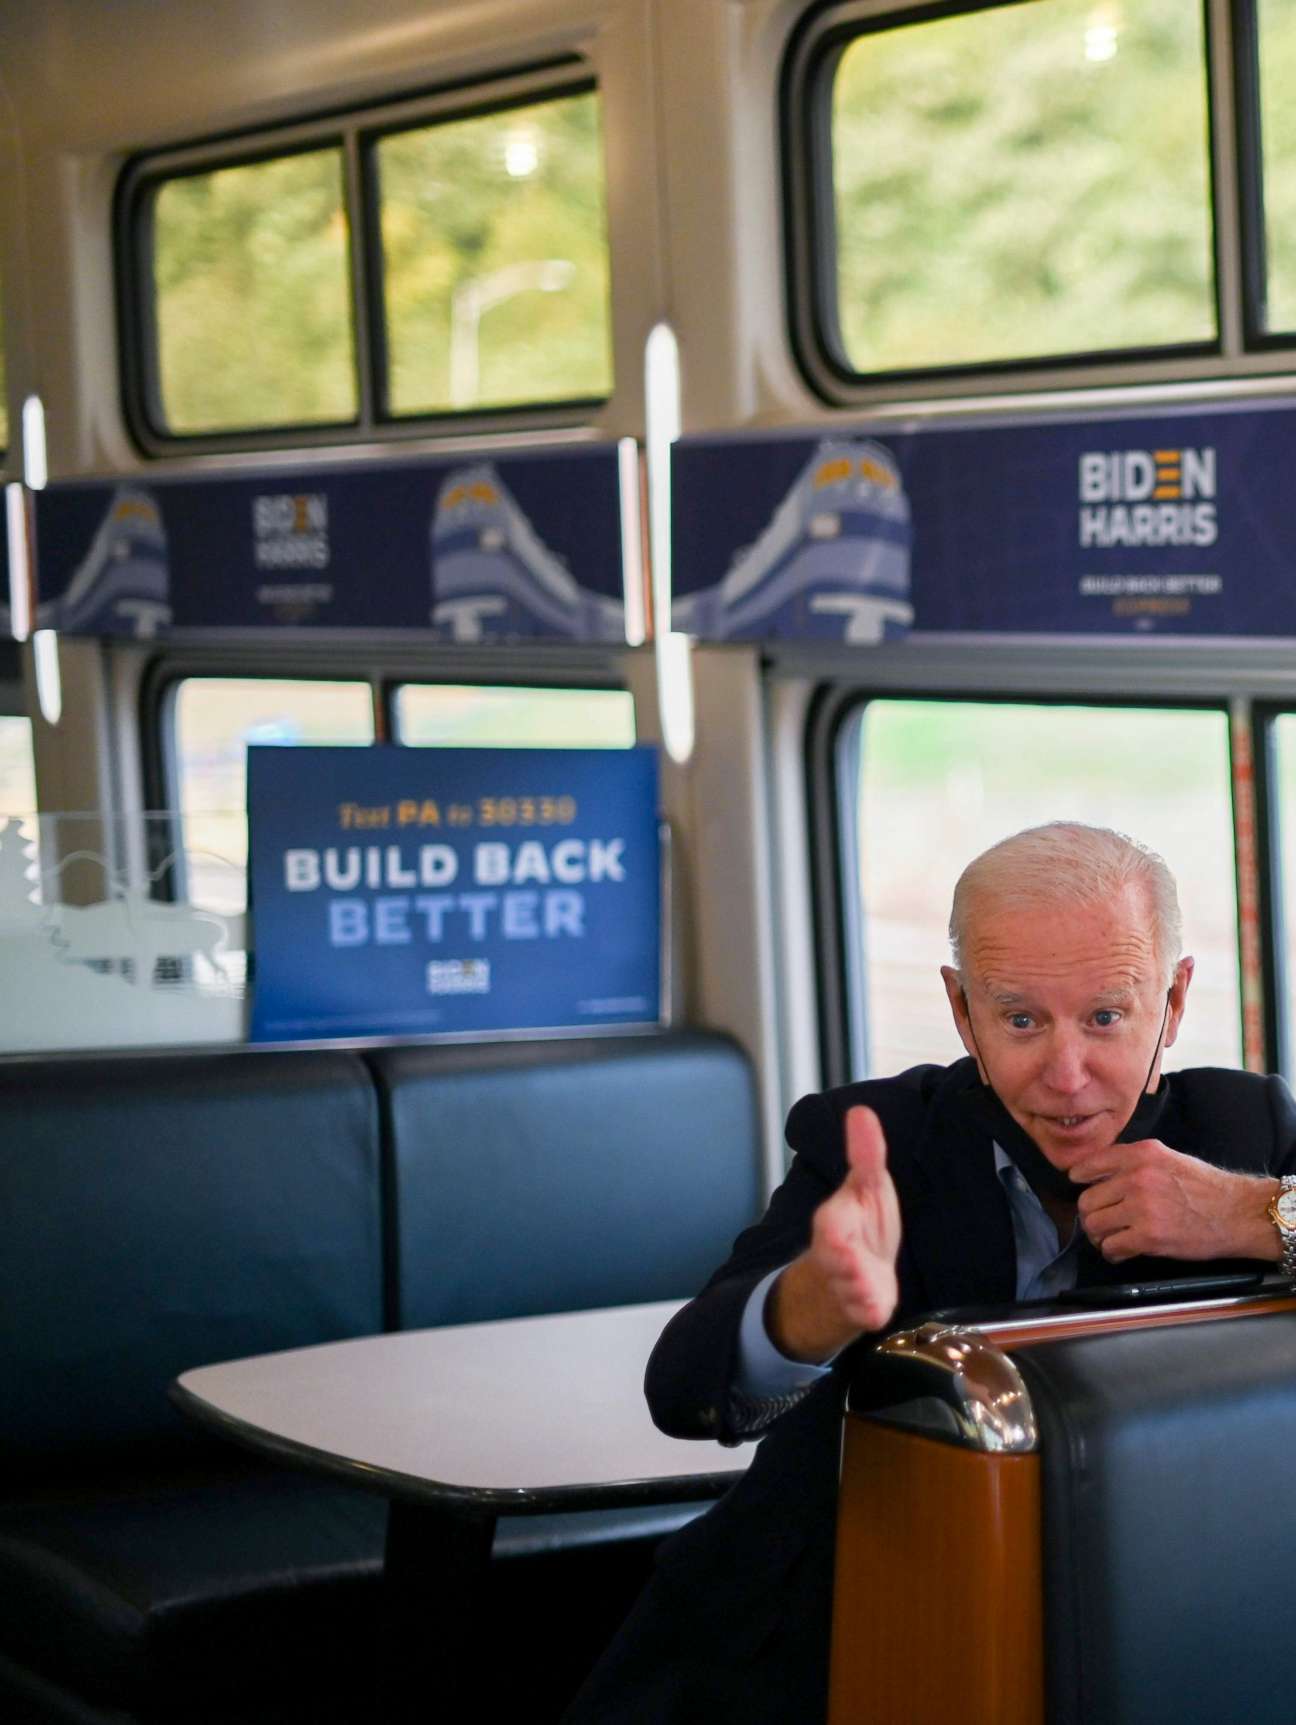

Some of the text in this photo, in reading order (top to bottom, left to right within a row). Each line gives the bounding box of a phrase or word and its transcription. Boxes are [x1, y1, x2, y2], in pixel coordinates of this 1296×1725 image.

[1080, 449, 1216, 501] BIDEN
[1080, 503, 1218, 547] HARRIS
[397, 799, 439, 828] PA
[284, 839, 626, 892] BUILD BACK
[328, 889, 585, 947] BETTER
